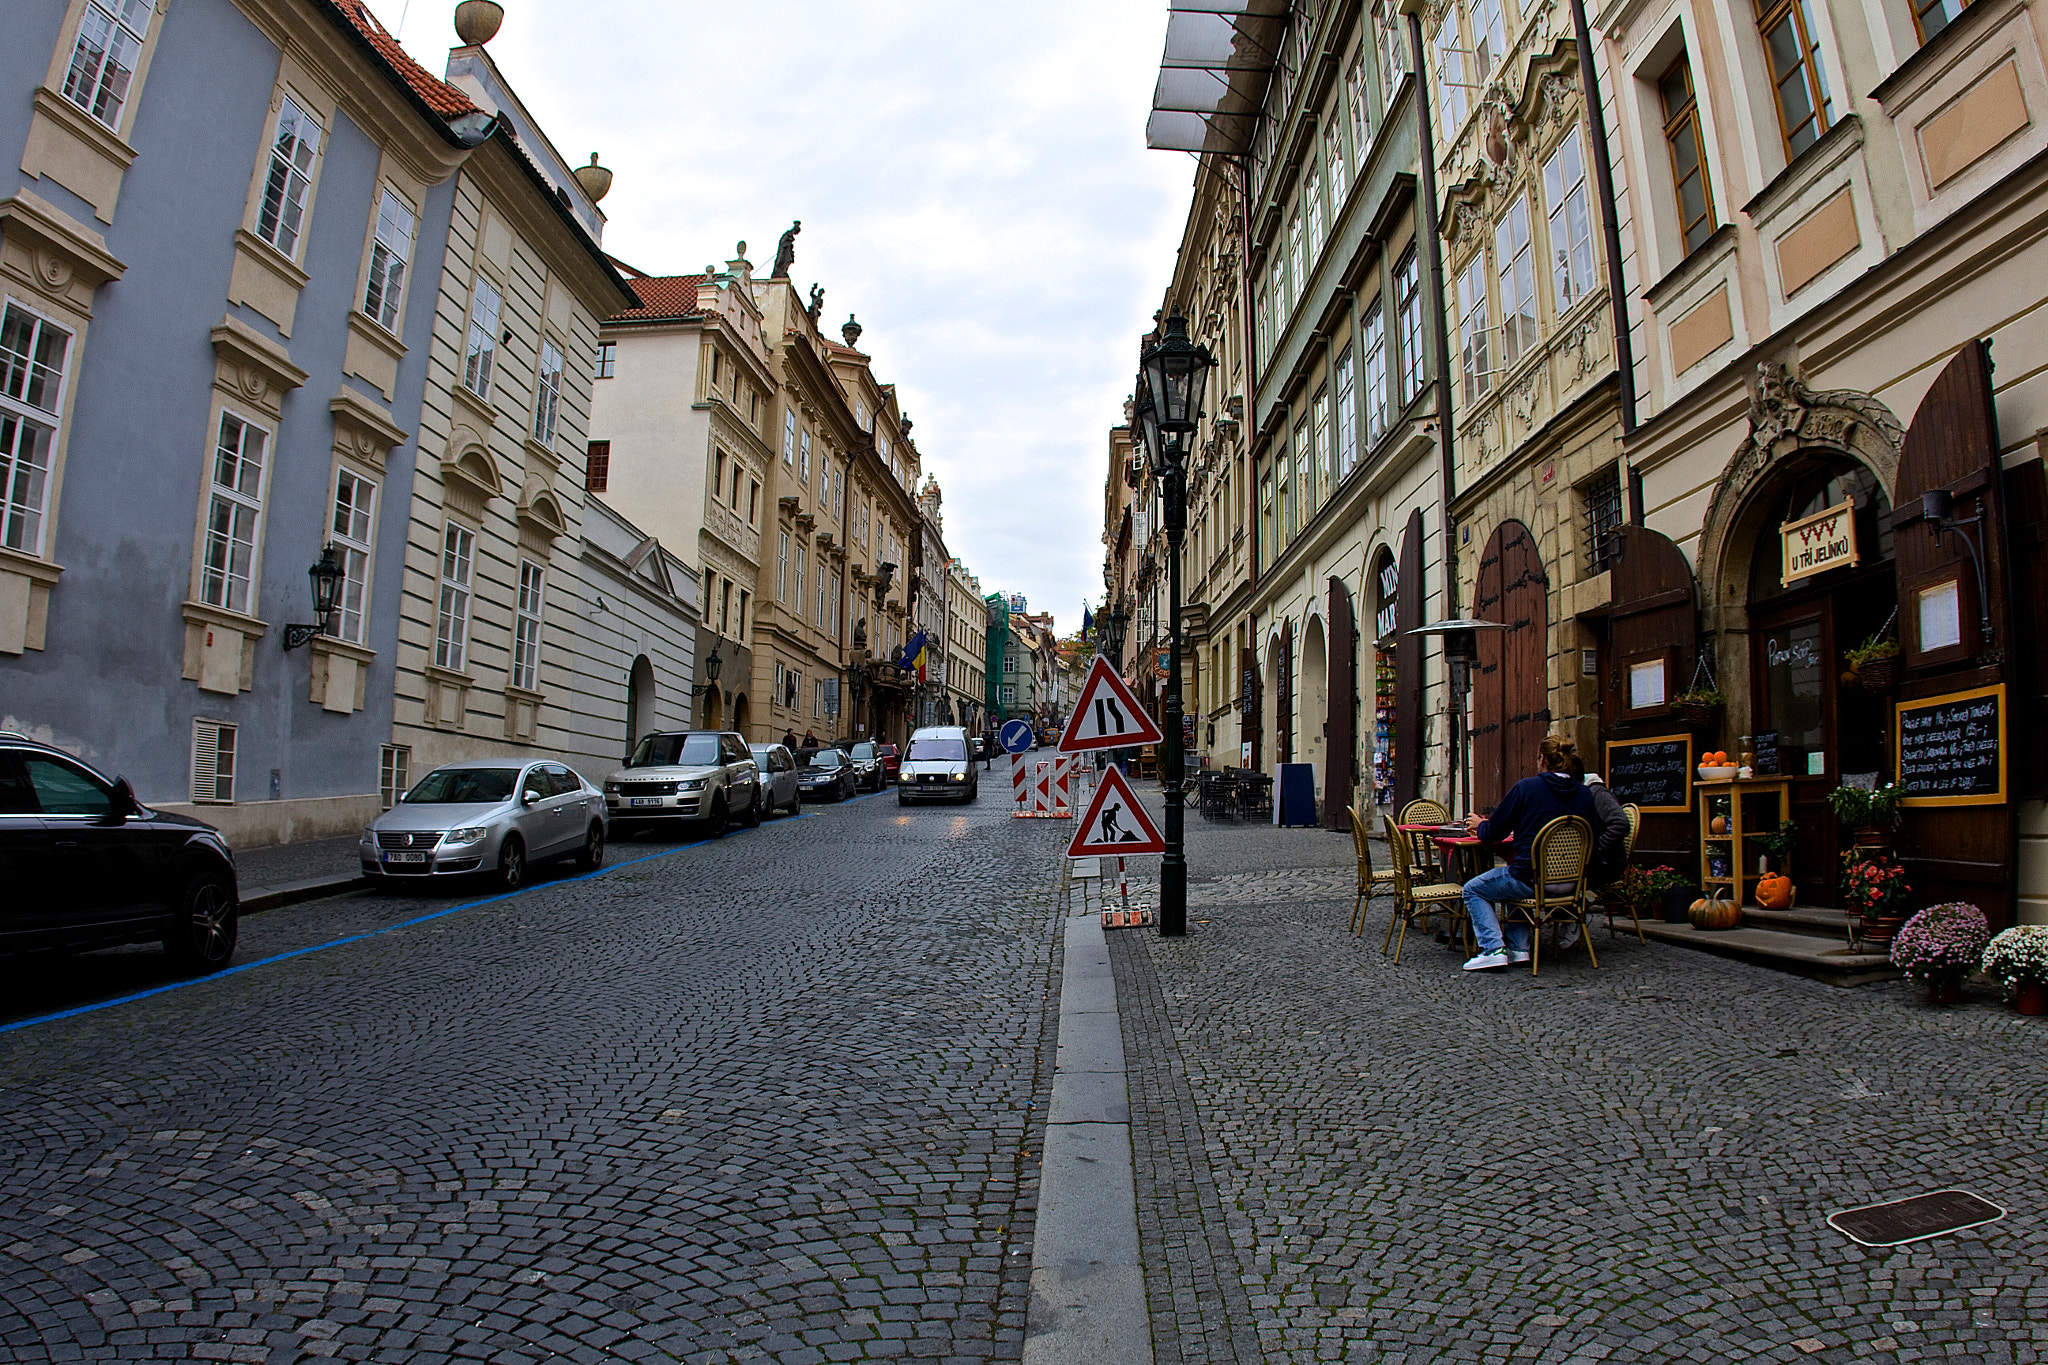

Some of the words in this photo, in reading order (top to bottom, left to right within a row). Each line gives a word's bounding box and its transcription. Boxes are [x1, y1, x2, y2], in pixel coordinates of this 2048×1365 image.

[1792, 556, 1798, 571] U
[1799, 548, 1813, 569] TŘÍ
[1814, 535, 1849, 564] JELÍNKŮ
[1380, 561, 1399, 600] MIN
[1377, 600, 1399, 640] MAR
